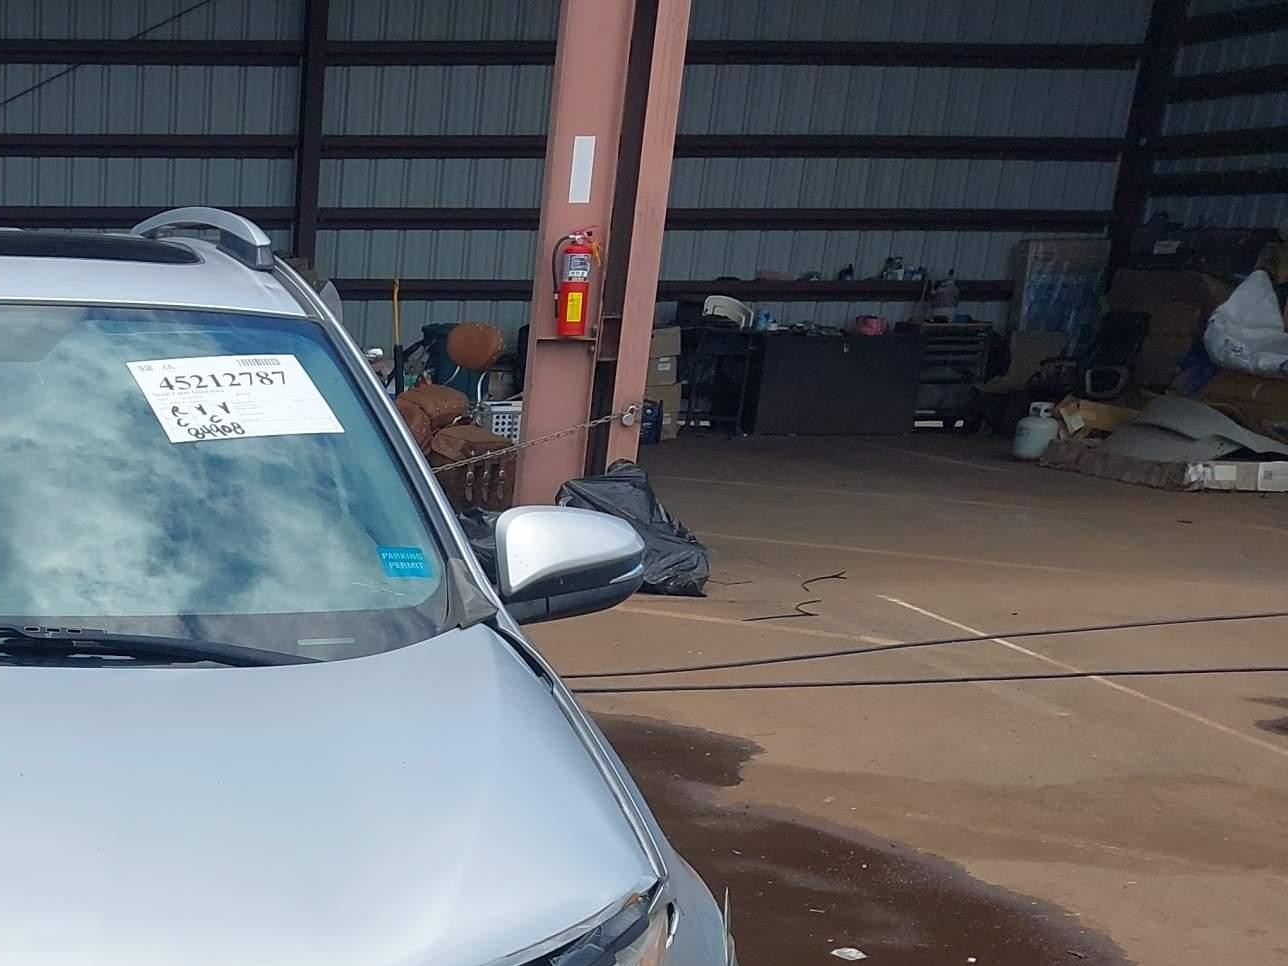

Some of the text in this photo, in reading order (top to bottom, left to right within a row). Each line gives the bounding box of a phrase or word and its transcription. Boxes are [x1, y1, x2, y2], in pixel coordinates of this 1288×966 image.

[159, 371, 285, 390] 45212787
[381, 552, 424, 561] PARKING
[388, 561, 425, 569] PERMIT
